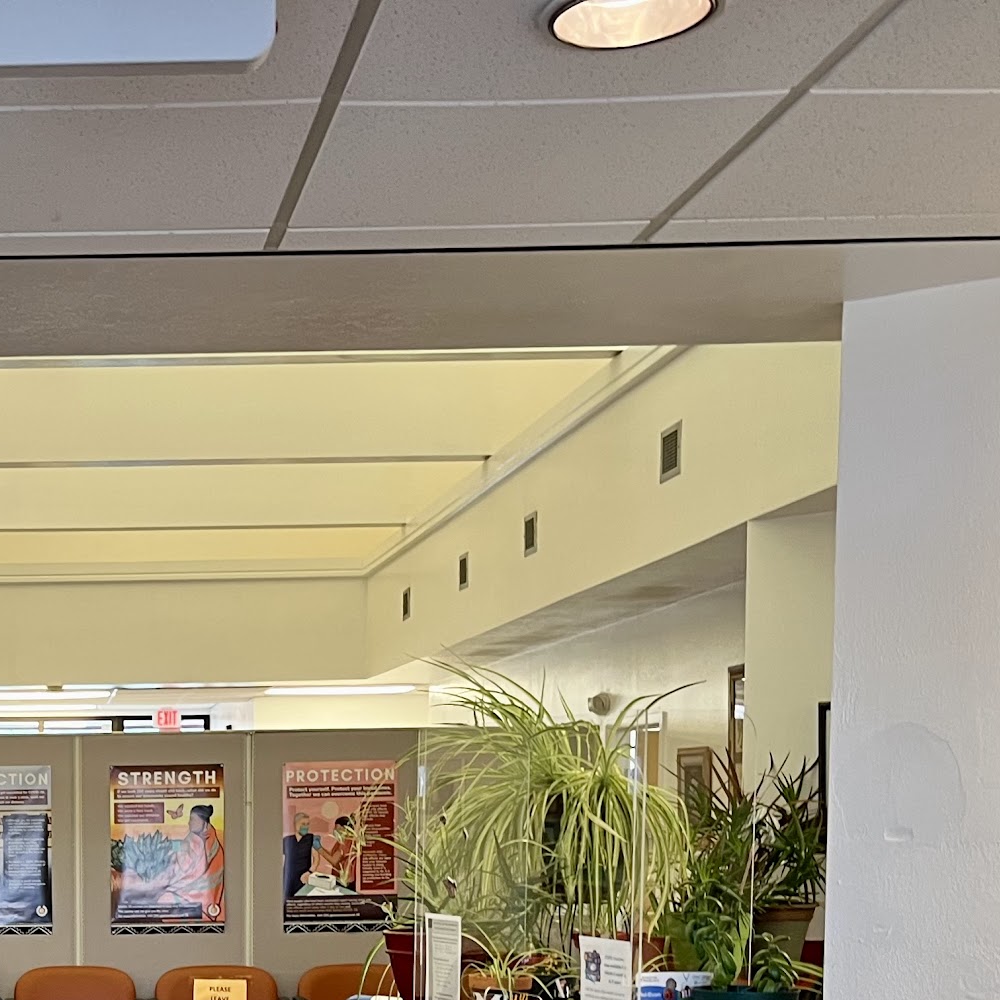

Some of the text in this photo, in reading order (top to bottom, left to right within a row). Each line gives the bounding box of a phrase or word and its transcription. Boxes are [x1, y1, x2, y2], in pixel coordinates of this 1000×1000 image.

[157, 710, 178, 726] EXIT
[117, 770, 216, 786] STRENGTH
[286, 768, 395, 783] PROTECTION
